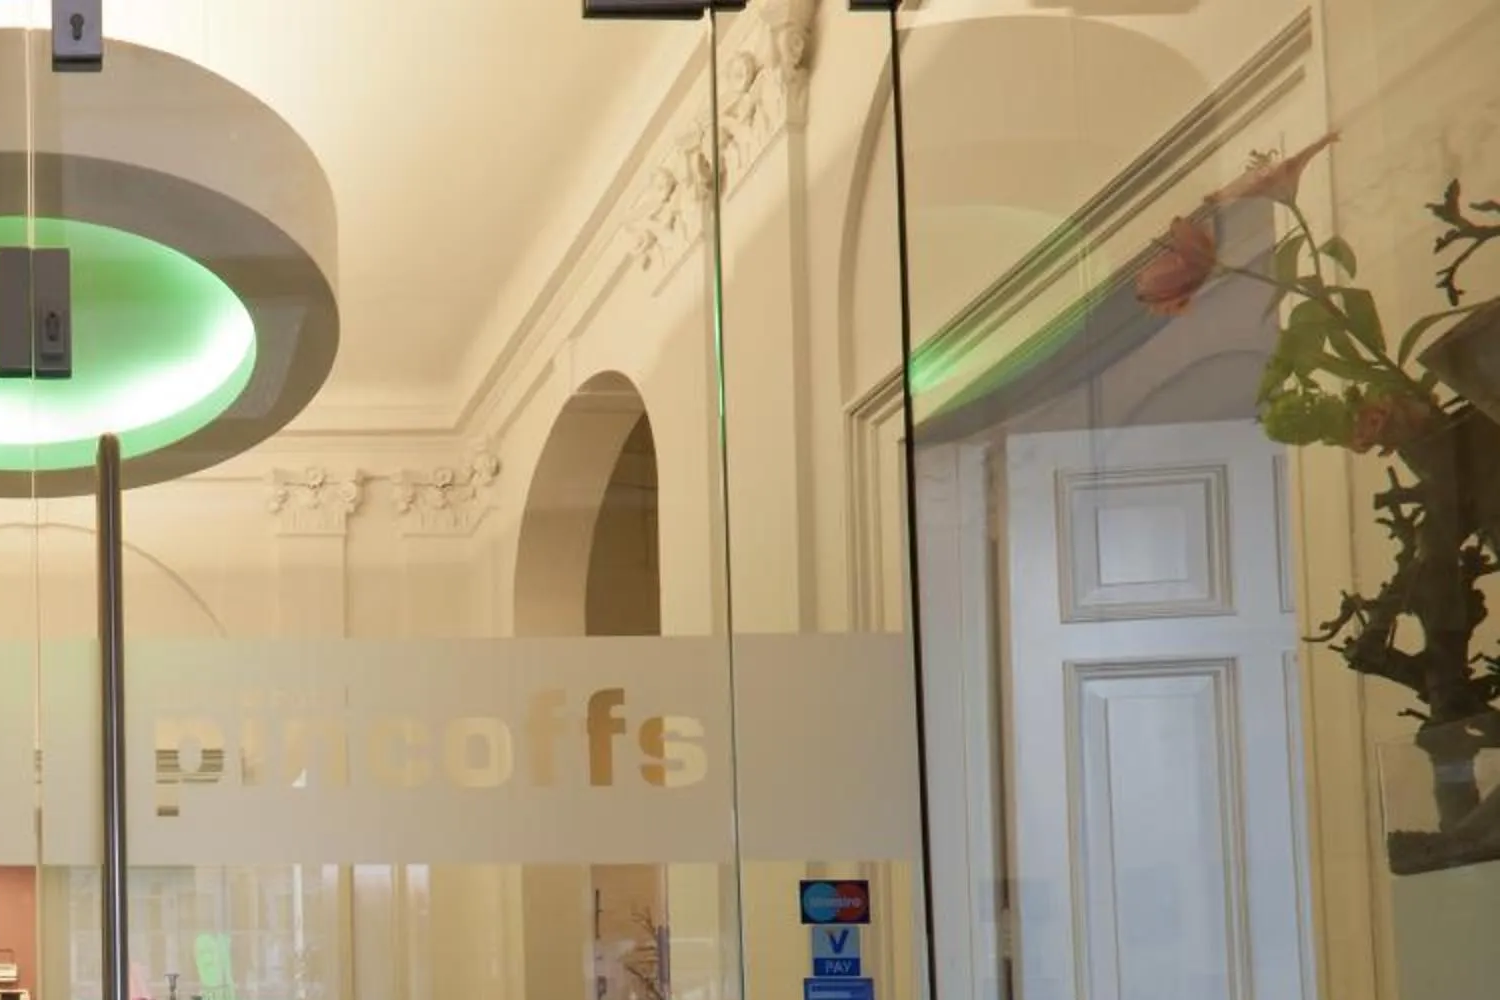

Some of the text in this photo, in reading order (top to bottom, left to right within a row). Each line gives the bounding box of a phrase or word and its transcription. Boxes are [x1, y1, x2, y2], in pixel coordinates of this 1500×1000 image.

[153, 687, 709, 817] pincoffs
[826, 929, 850, 955] V
[824, 960, 853, 975] PAY
